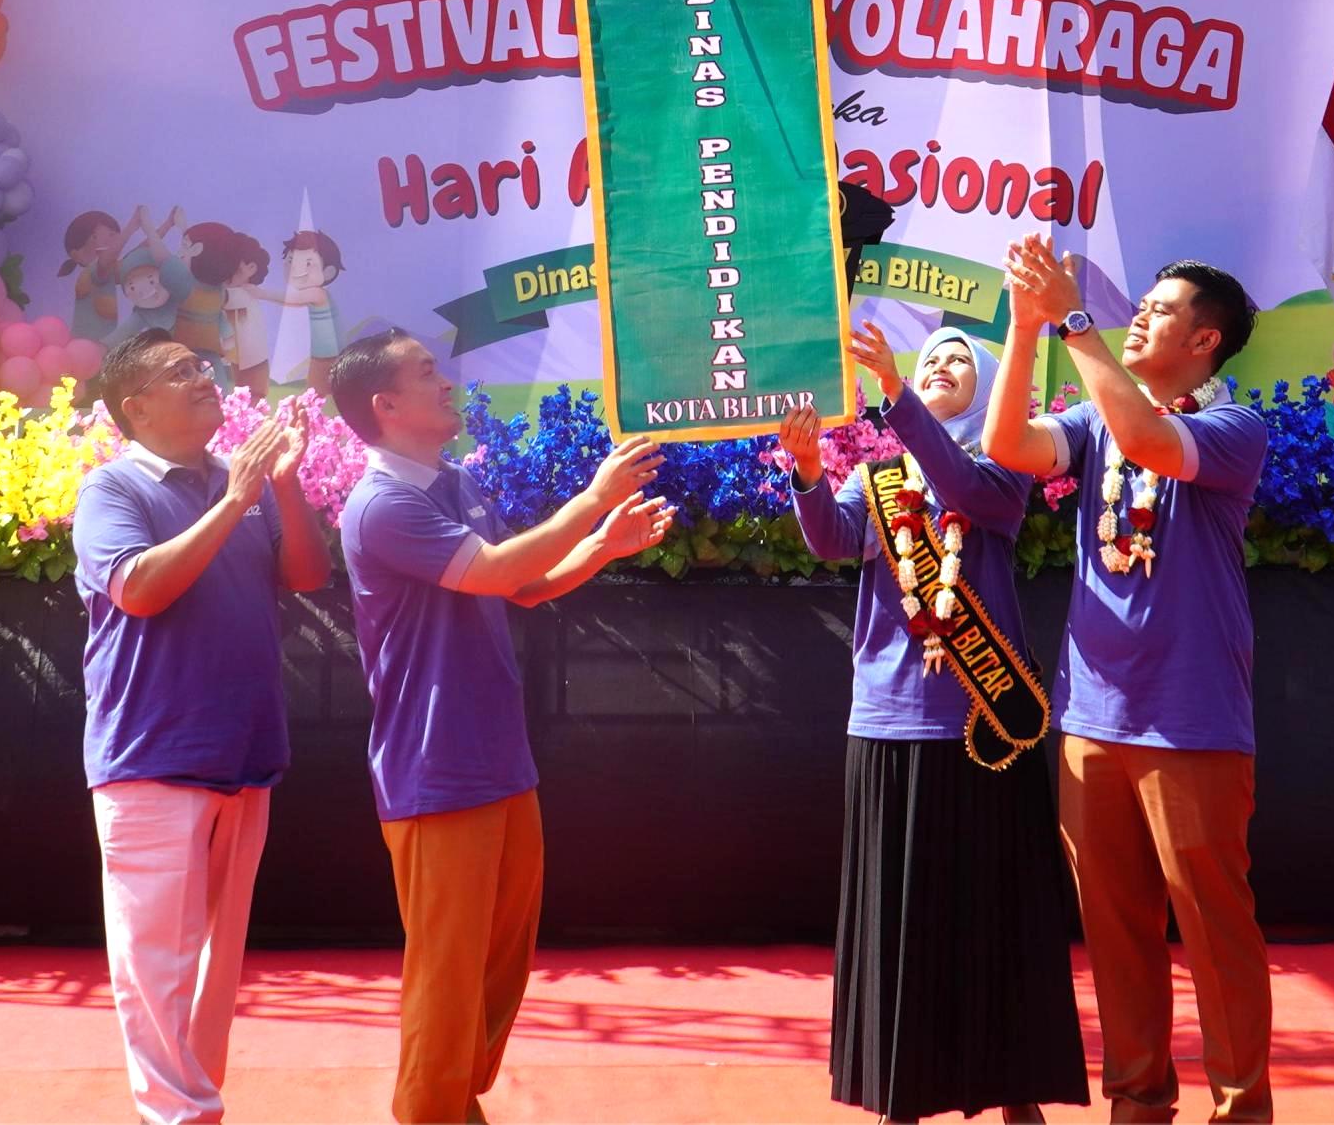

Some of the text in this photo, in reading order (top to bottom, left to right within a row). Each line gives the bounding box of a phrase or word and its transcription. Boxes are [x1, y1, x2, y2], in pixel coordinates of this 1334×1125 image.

[378, 140, 540, 228] Hari
[837, 139, 1104, 230] asional
[697, 137, 746, 391] PENDIDIKAN
[887, 256, 980, 304] Blitar
[645, 391, 815, 425] KOTA BLITAR
[950, 625, 1014, 703] BLITAR
